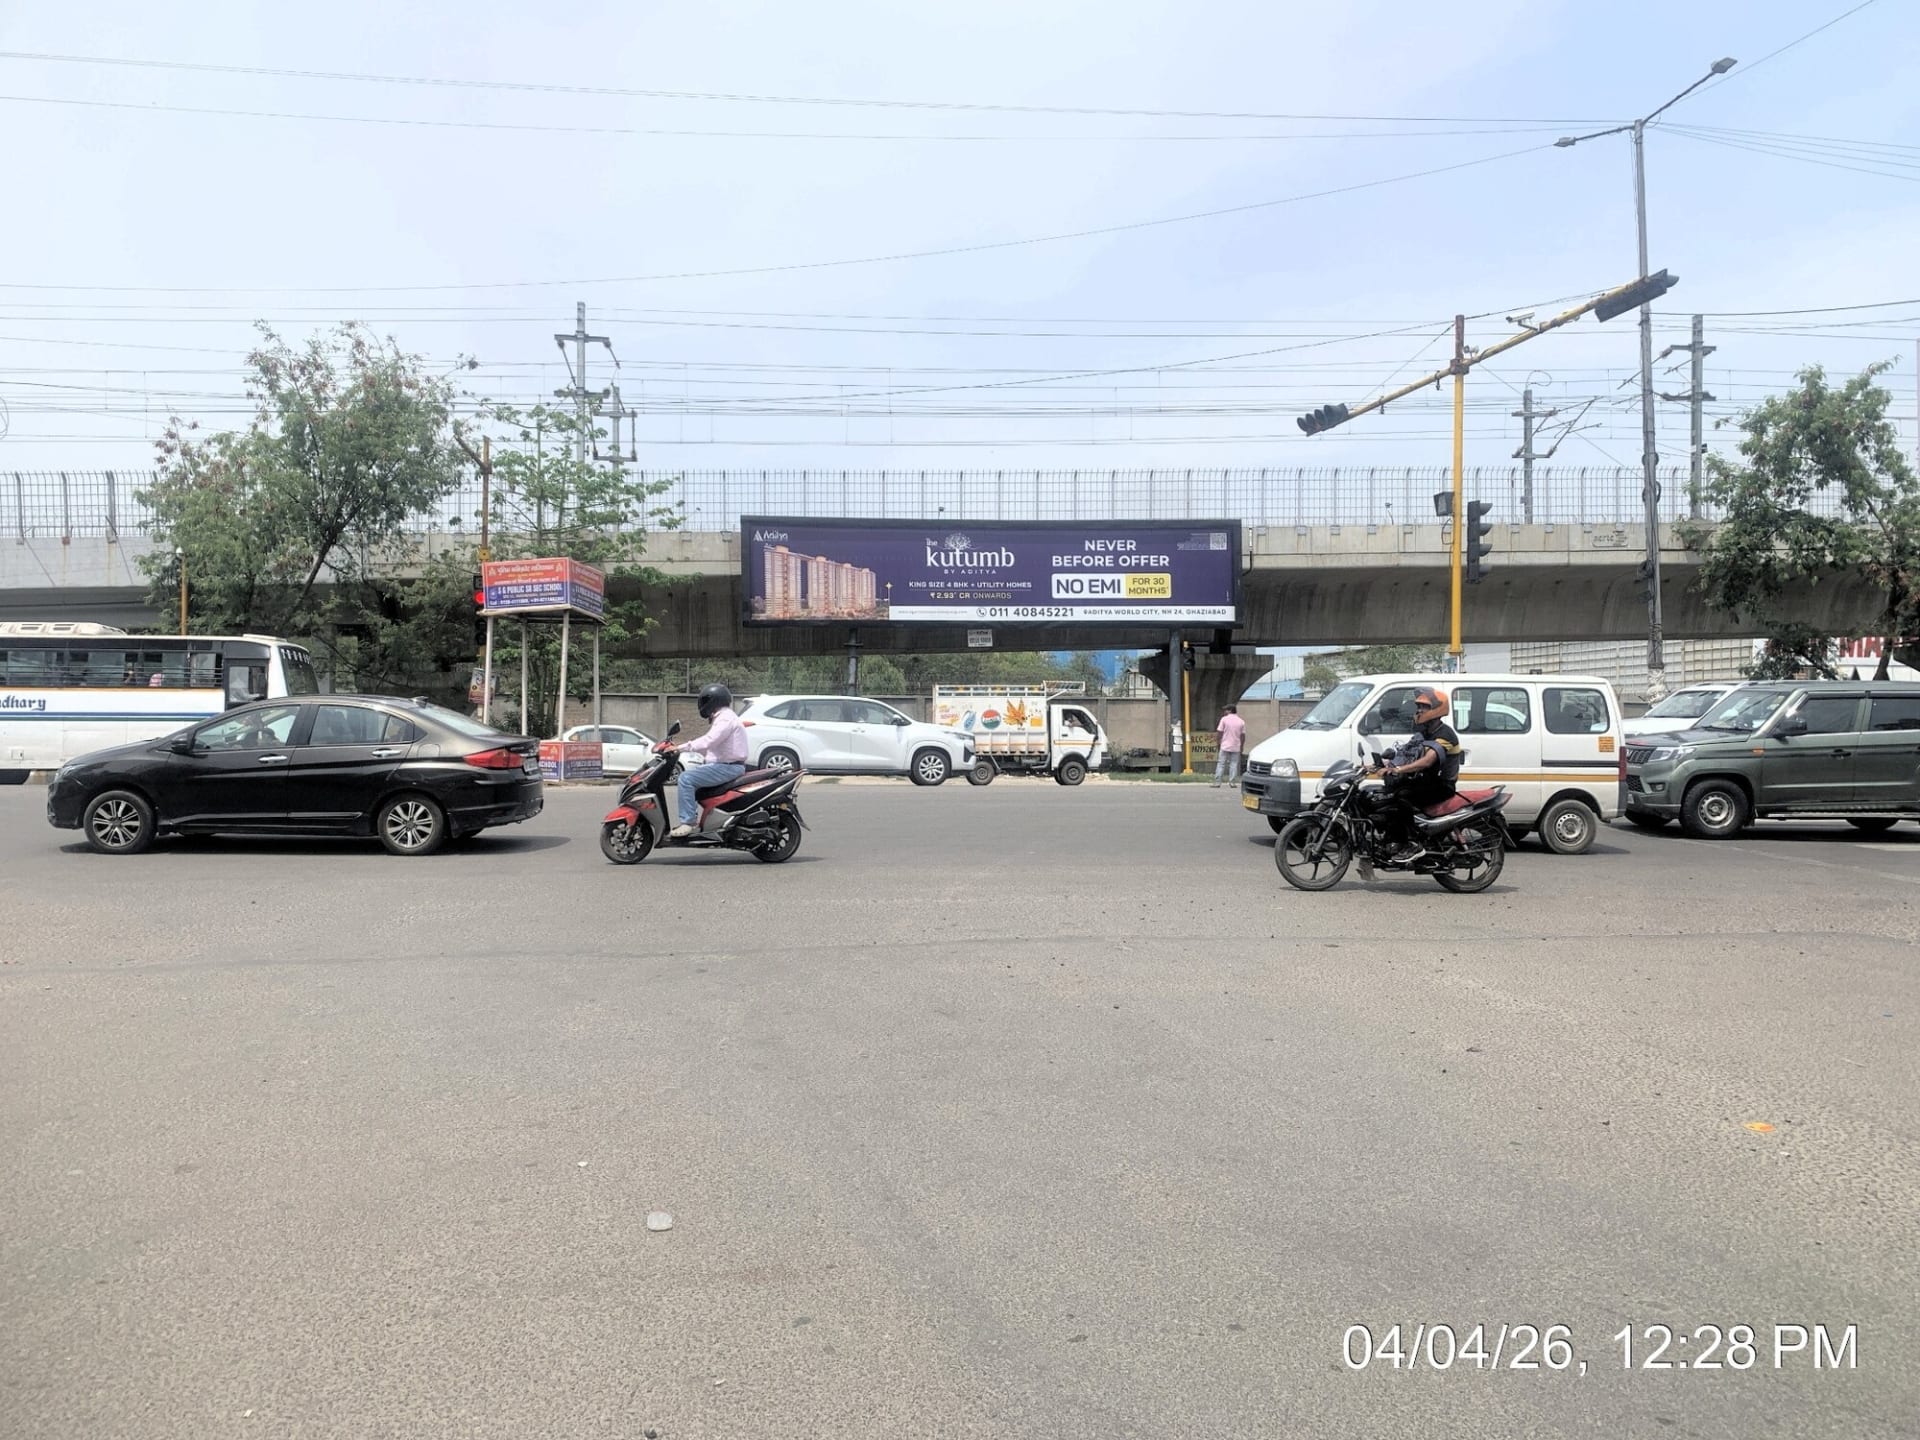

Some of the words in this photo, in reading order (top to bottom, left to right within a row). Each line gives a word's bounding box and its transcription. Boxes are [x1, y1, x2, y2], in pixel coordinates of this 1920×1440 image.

[926, 538, 938, 546] the
[1084, 540, 1137, 551] NEVER
[926, 546, 1015, 567] kutumb
[1052, 555, 1114, 567] BEFORE
[1119, 555, 1170, 567] OFFER
[1056, 579, 1084, 594] NO
[1088, 579, 1121, 594] EMI
[1132, 577, 1151, 585] FOR
[1153, 577, 1165, 585] 30
[507, 585, 525, 594] PUBLIC
[543, 583, 563, 592] SCHOOL
[989, 607, 1009, 617] 011
[1013, 607, 1074, 617] 40845221
[0, 694, 46, 711] dhary
